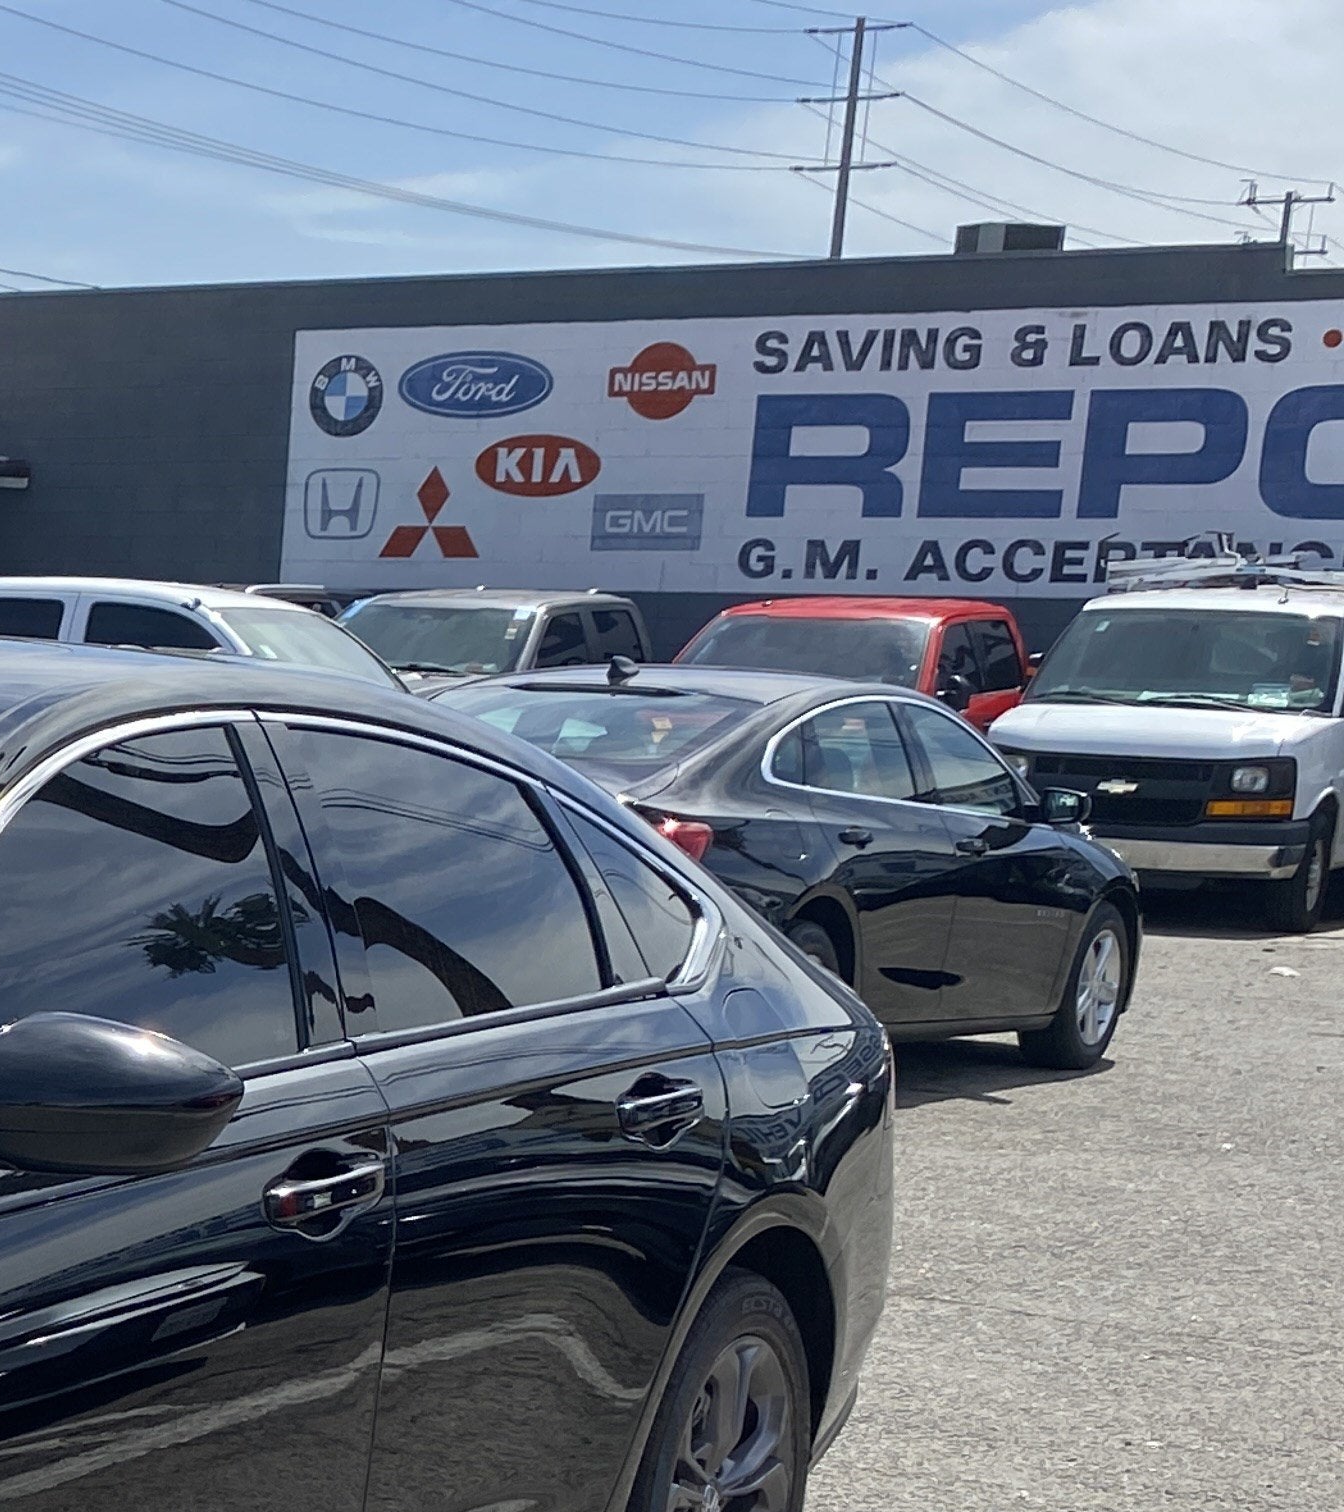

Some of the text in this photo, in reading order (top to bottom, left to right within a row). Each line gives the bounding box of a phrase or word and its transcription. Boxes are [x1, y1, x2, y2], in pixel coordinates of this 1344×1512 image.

[753, 318, 1292, 374] SAVING & LOANS
[431, 365, 517, 401] Ford
[613, 370, 710, 392] NISSAN
[494, 447, 583, 483] KIA
[605, 509, 688, 534] GMC
[737, 539, 877, 580] G.M.
